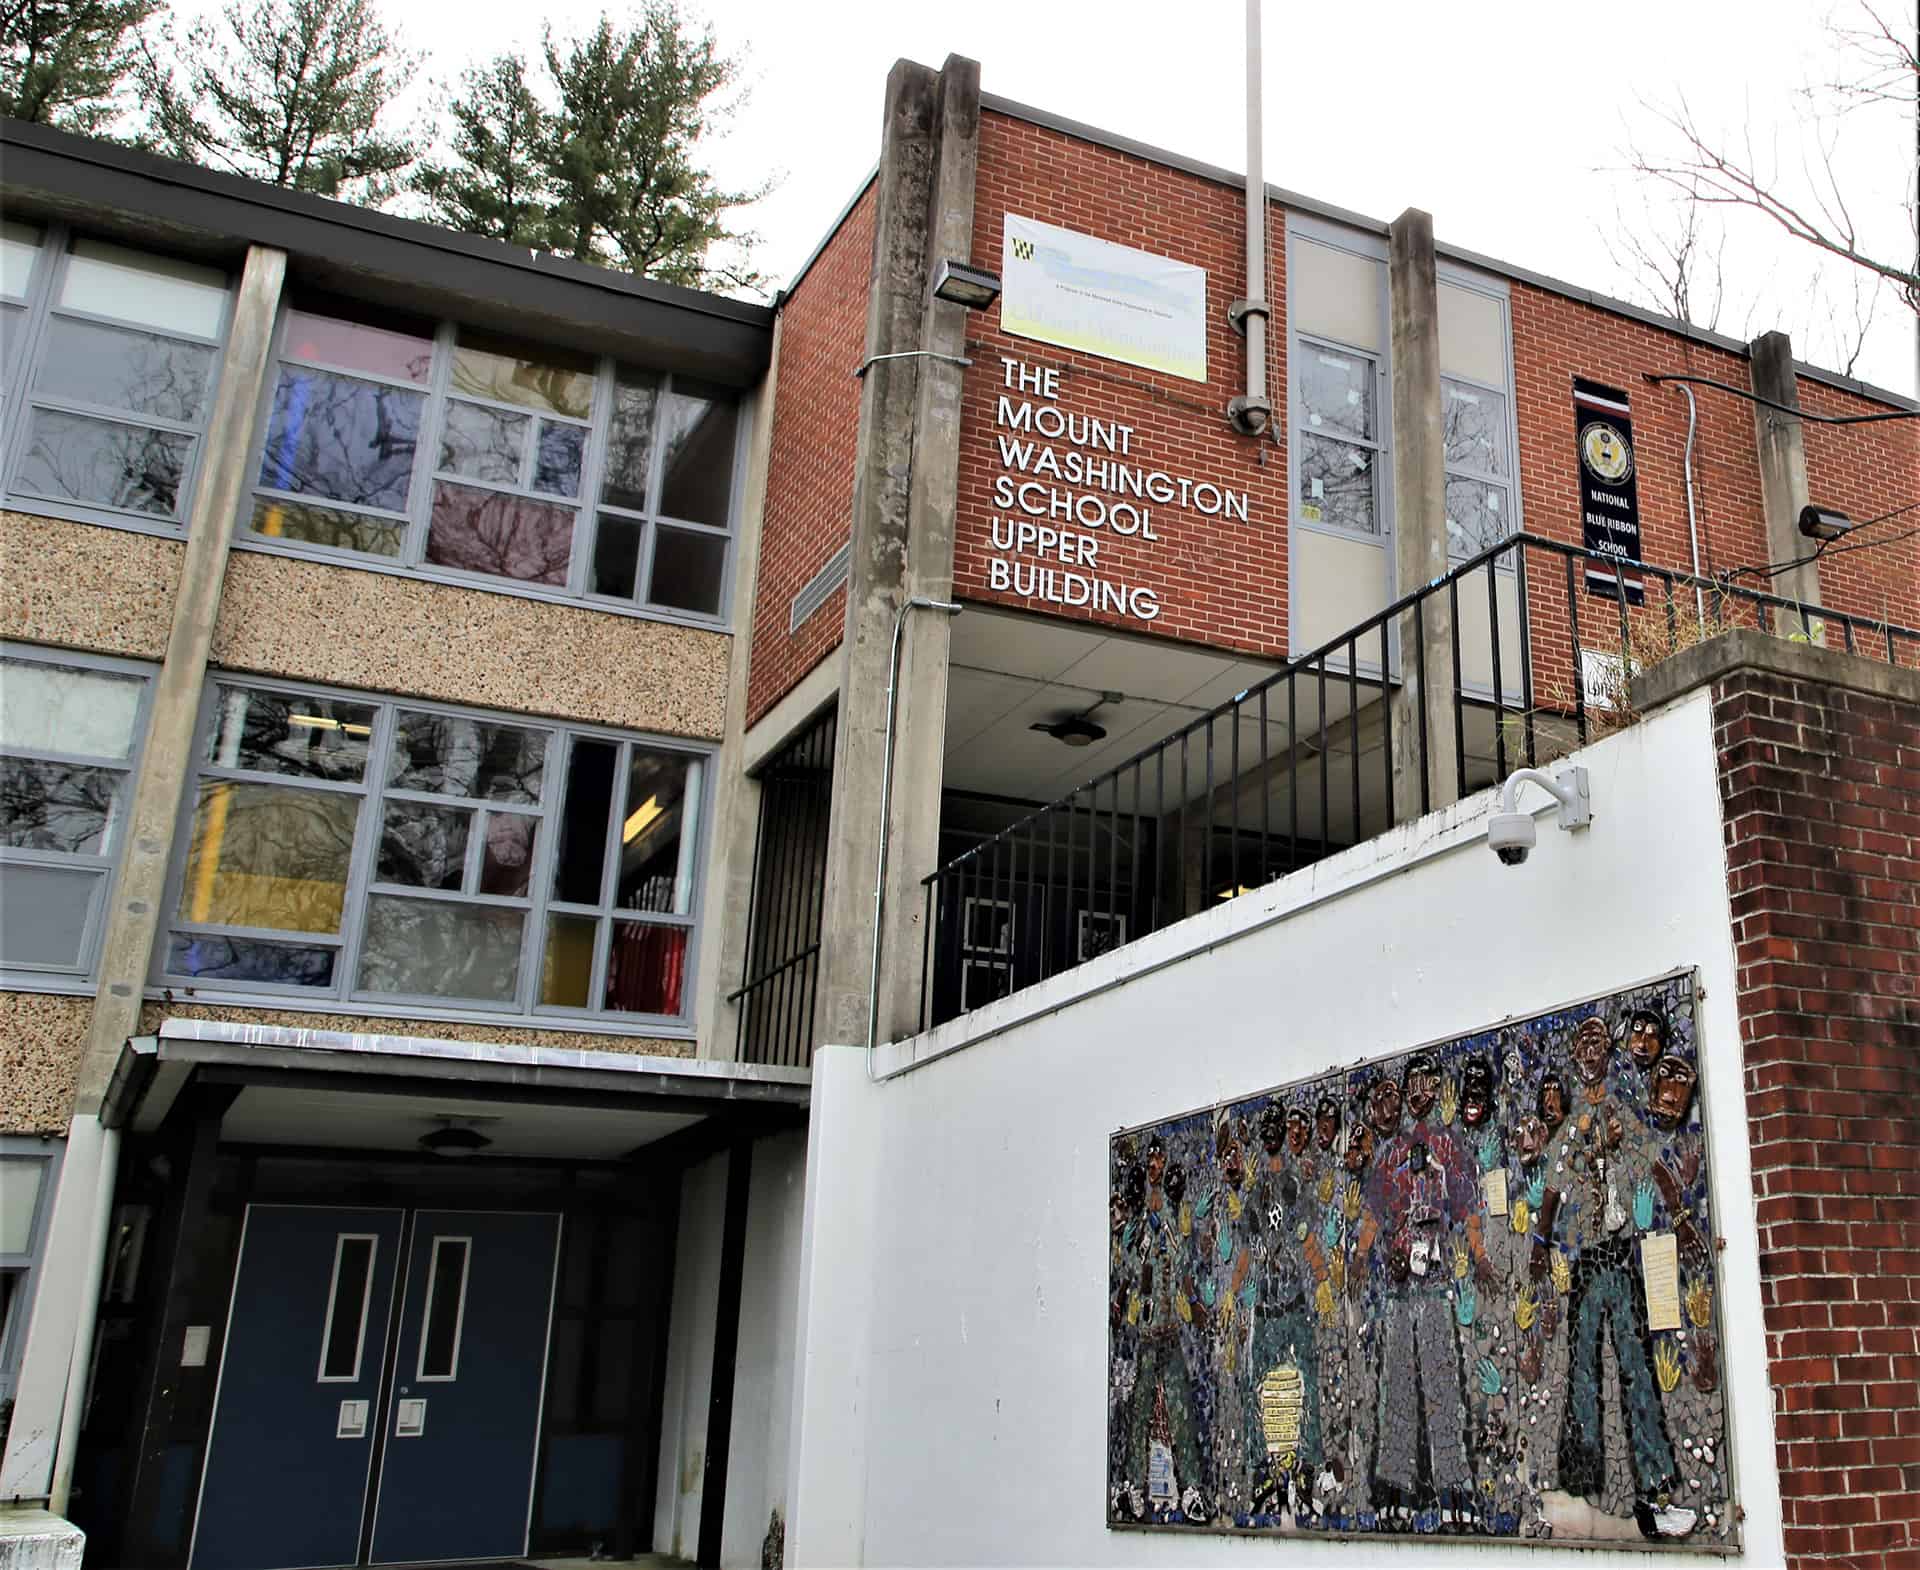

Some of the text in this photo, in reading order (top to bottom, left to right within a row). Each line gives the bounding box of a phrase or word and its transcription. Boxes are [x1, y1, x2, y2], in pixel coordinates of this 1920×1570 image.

[1000, 357, 1060, 400] THE
[998, 396, 1134, 455] MOUNT
[998, 435, 1249, 523] WASHINGTON
[1591, 489, 1630, 510] NATIONAL
[993, 476, 1158, 541] SCHOOL
[1586, 512, 1637, 536] BLUE RIBBON
[992, 516, 1099, 568] UPPER
[1598, 539, 1629, 557] SCHOOL
[990, 558, 1161, 620] BUILDING
